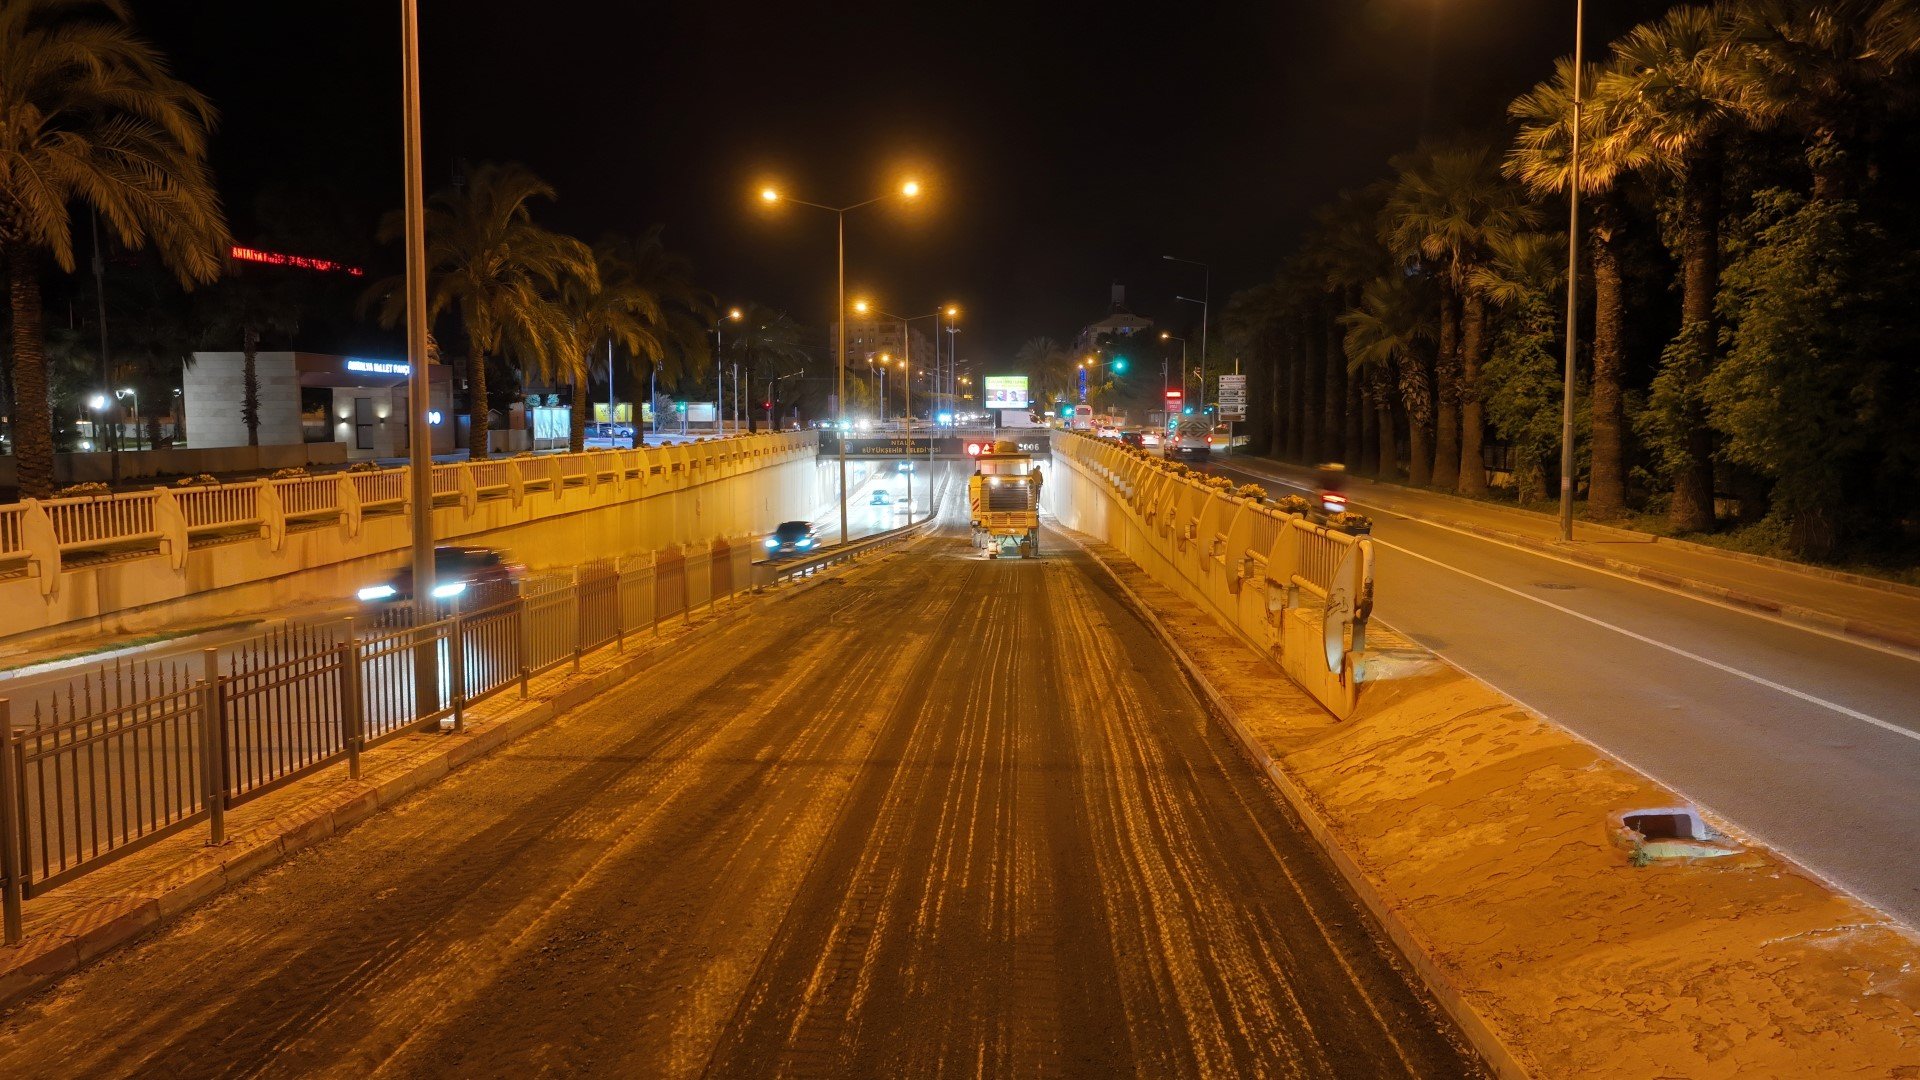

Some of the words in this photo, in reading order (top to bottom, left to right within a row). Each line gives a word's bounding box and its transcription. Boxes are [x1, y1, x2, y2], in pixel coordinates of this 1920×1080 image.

[232, 247, 263, 262] ANTALYA
[862, 446, 903, 454] BÜYÜKŞEHİR
[1018, 443, 1040, 451] 2006
